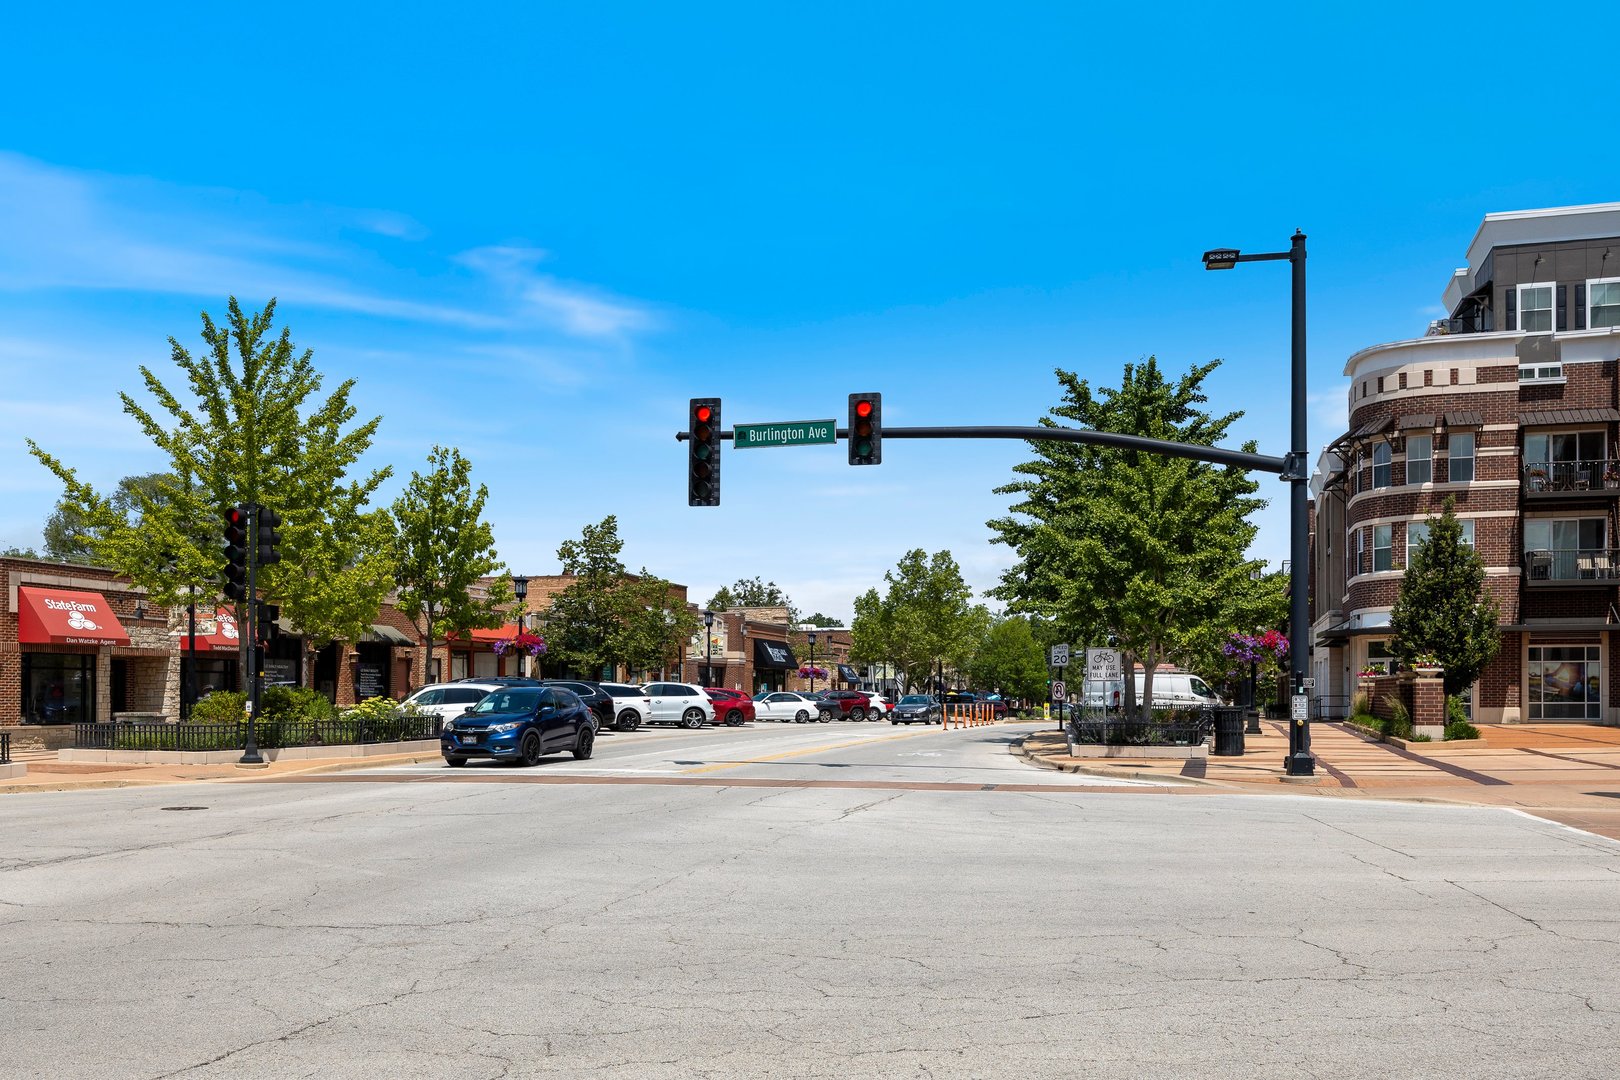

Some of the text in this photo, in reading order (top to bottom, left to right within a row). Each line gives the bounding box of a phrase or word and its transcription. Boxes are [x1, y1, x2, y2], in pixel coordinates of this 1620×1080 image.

[749, 426, 827, 444] Burlington Ave
[1053, 655, 1067, 664] 20
